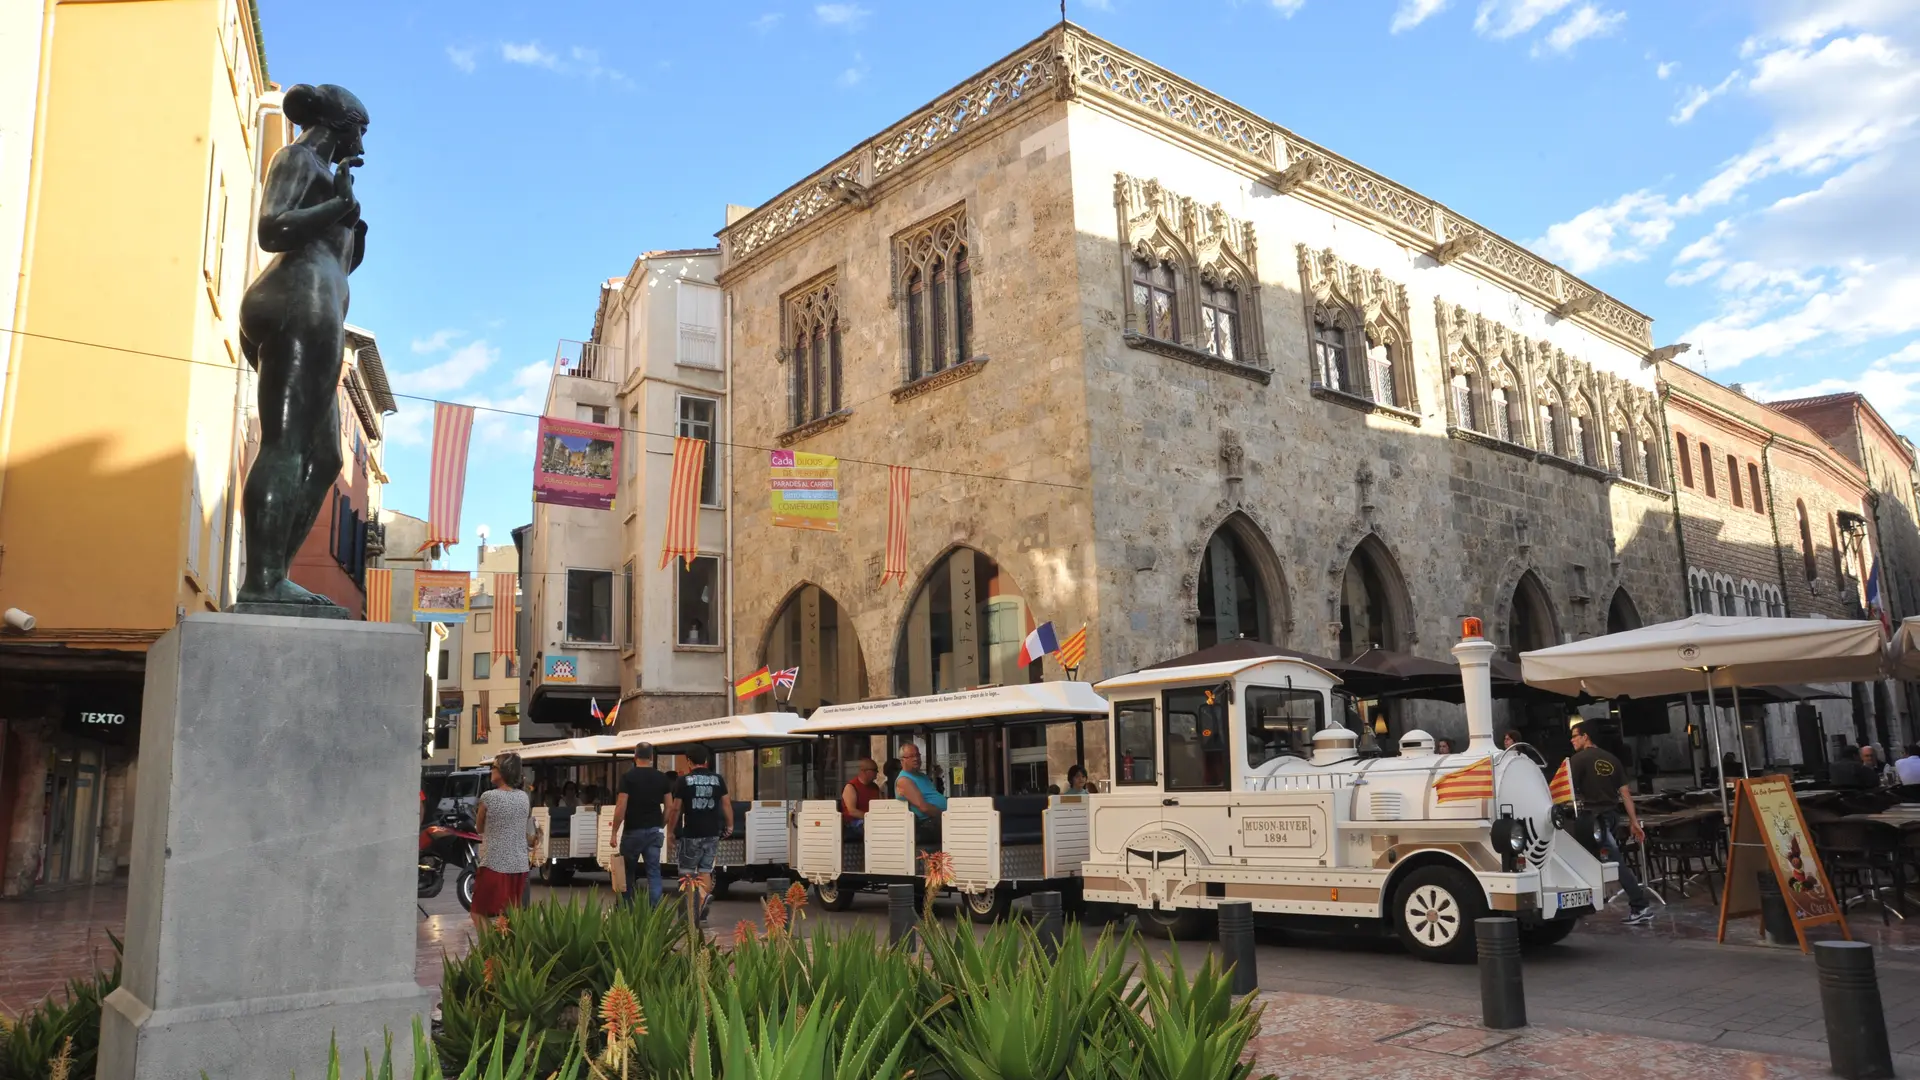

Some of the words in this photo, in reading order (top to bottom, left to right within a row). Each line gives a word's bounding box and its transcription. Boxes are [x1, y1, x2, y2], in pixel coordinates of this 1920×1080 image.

[772, 456, 793, 465] Cada
[80, 712, 125, 725] TEXTO
[1264, 833, 1288, 843] 1894
